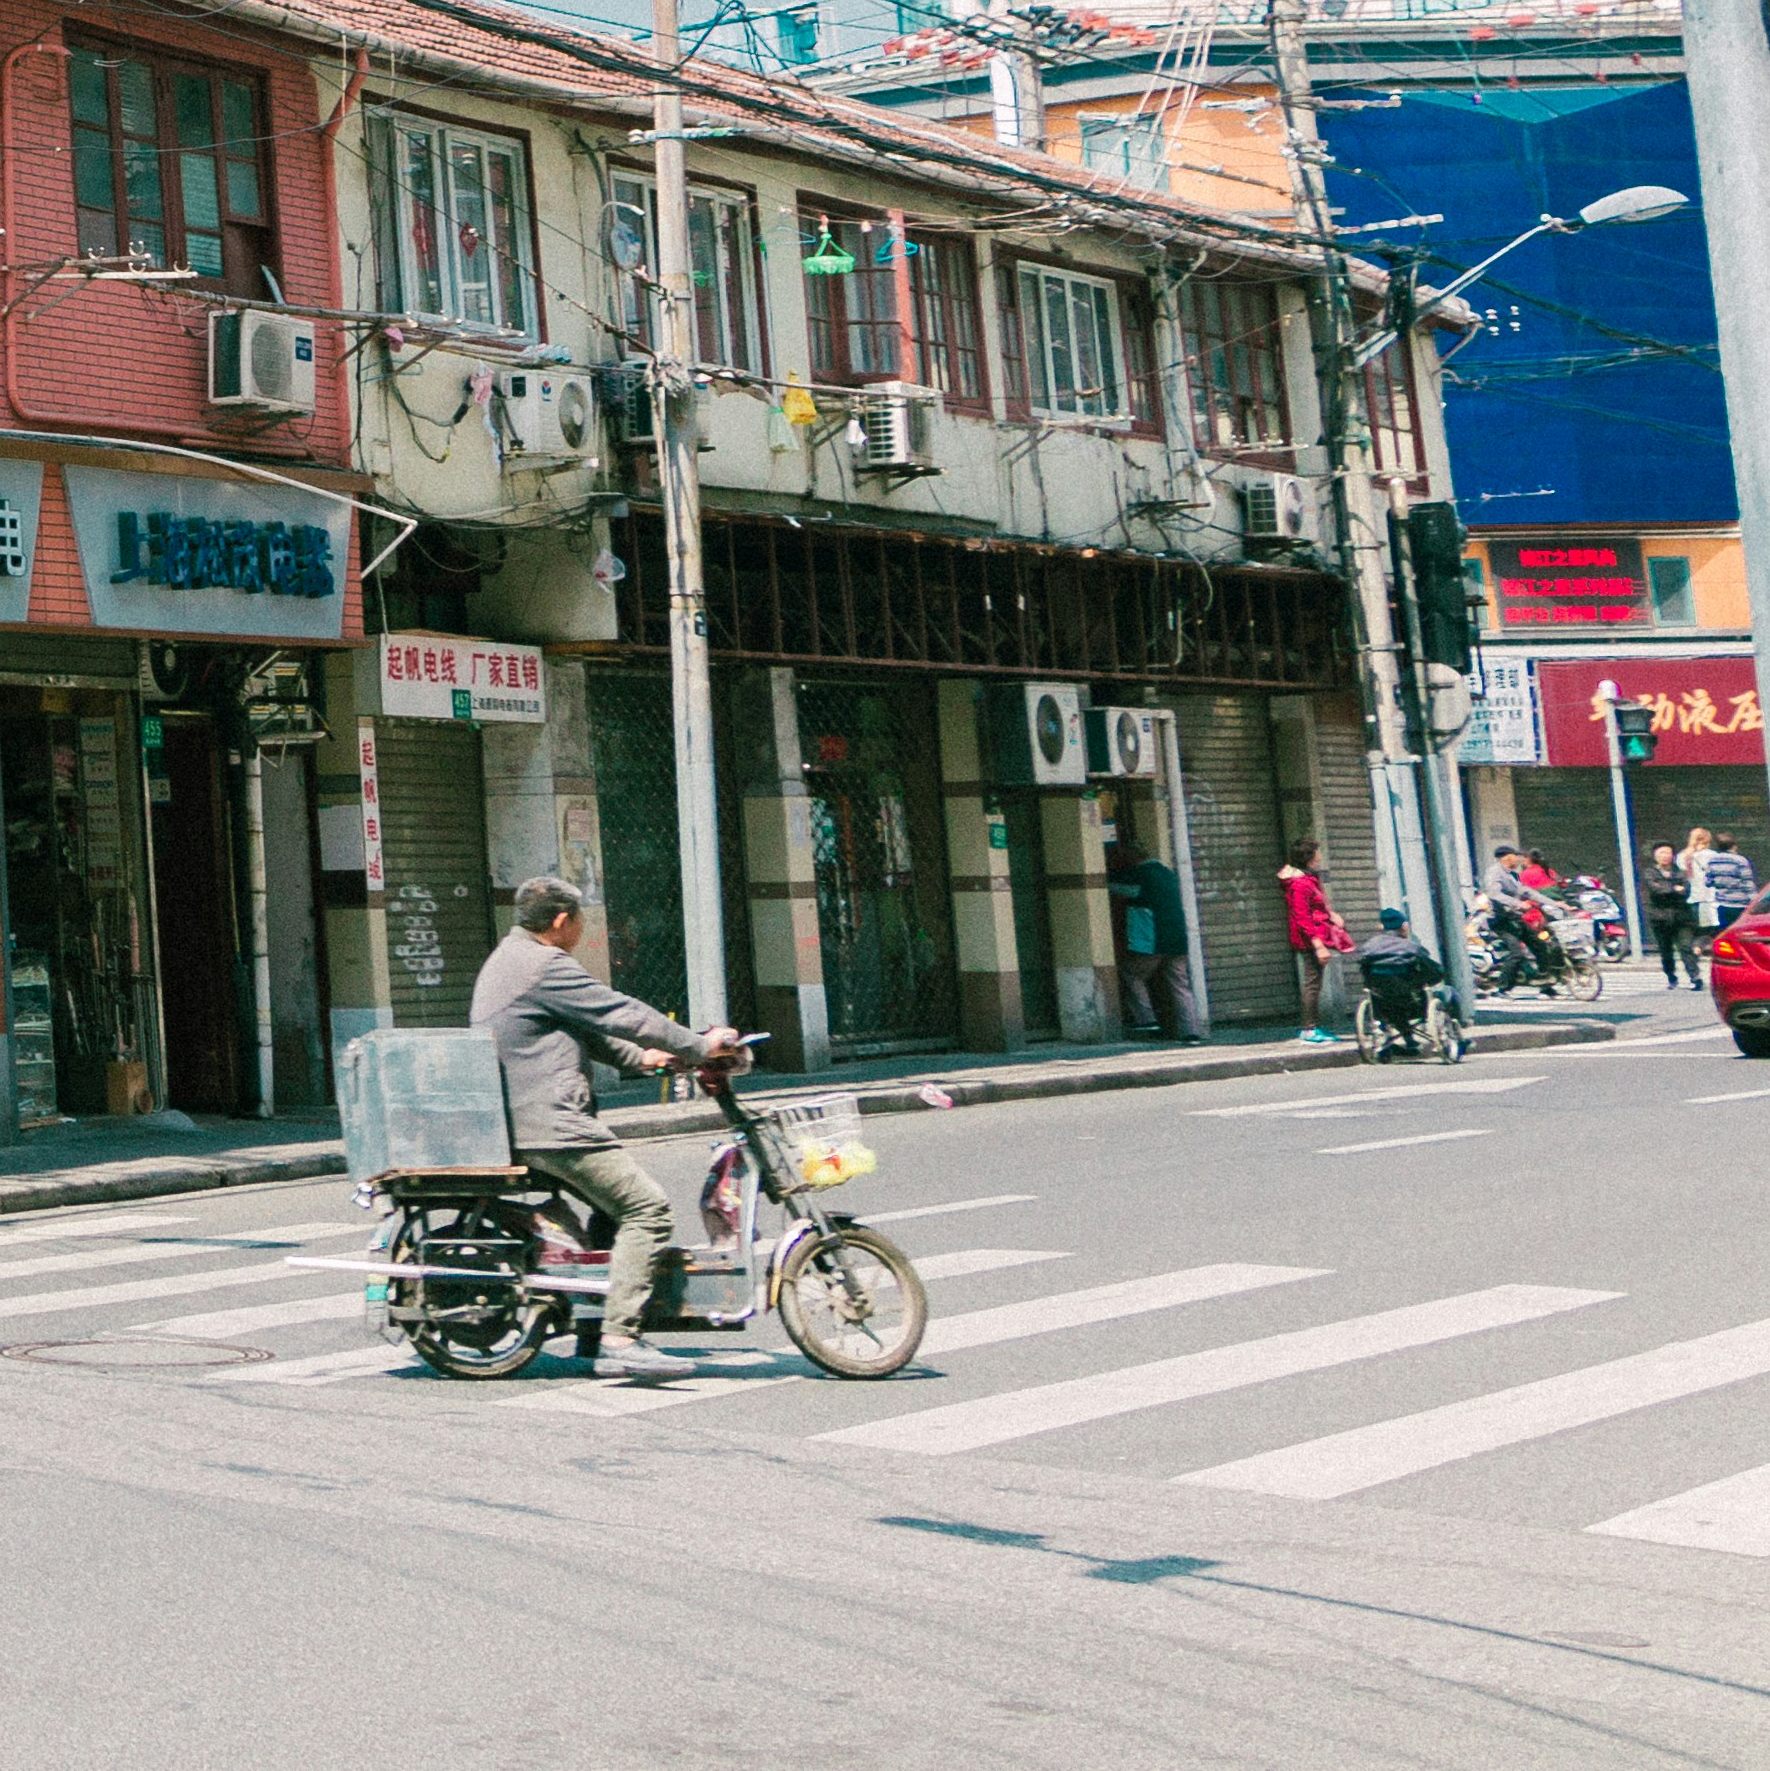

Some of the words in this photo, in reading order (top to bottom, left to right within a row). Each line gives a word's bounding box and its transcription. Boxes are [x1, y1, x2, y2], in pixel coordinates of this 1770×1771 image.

[387, 644, 457, 685] 起帆电线
[472, 651, 540, 691] 厂家直销
